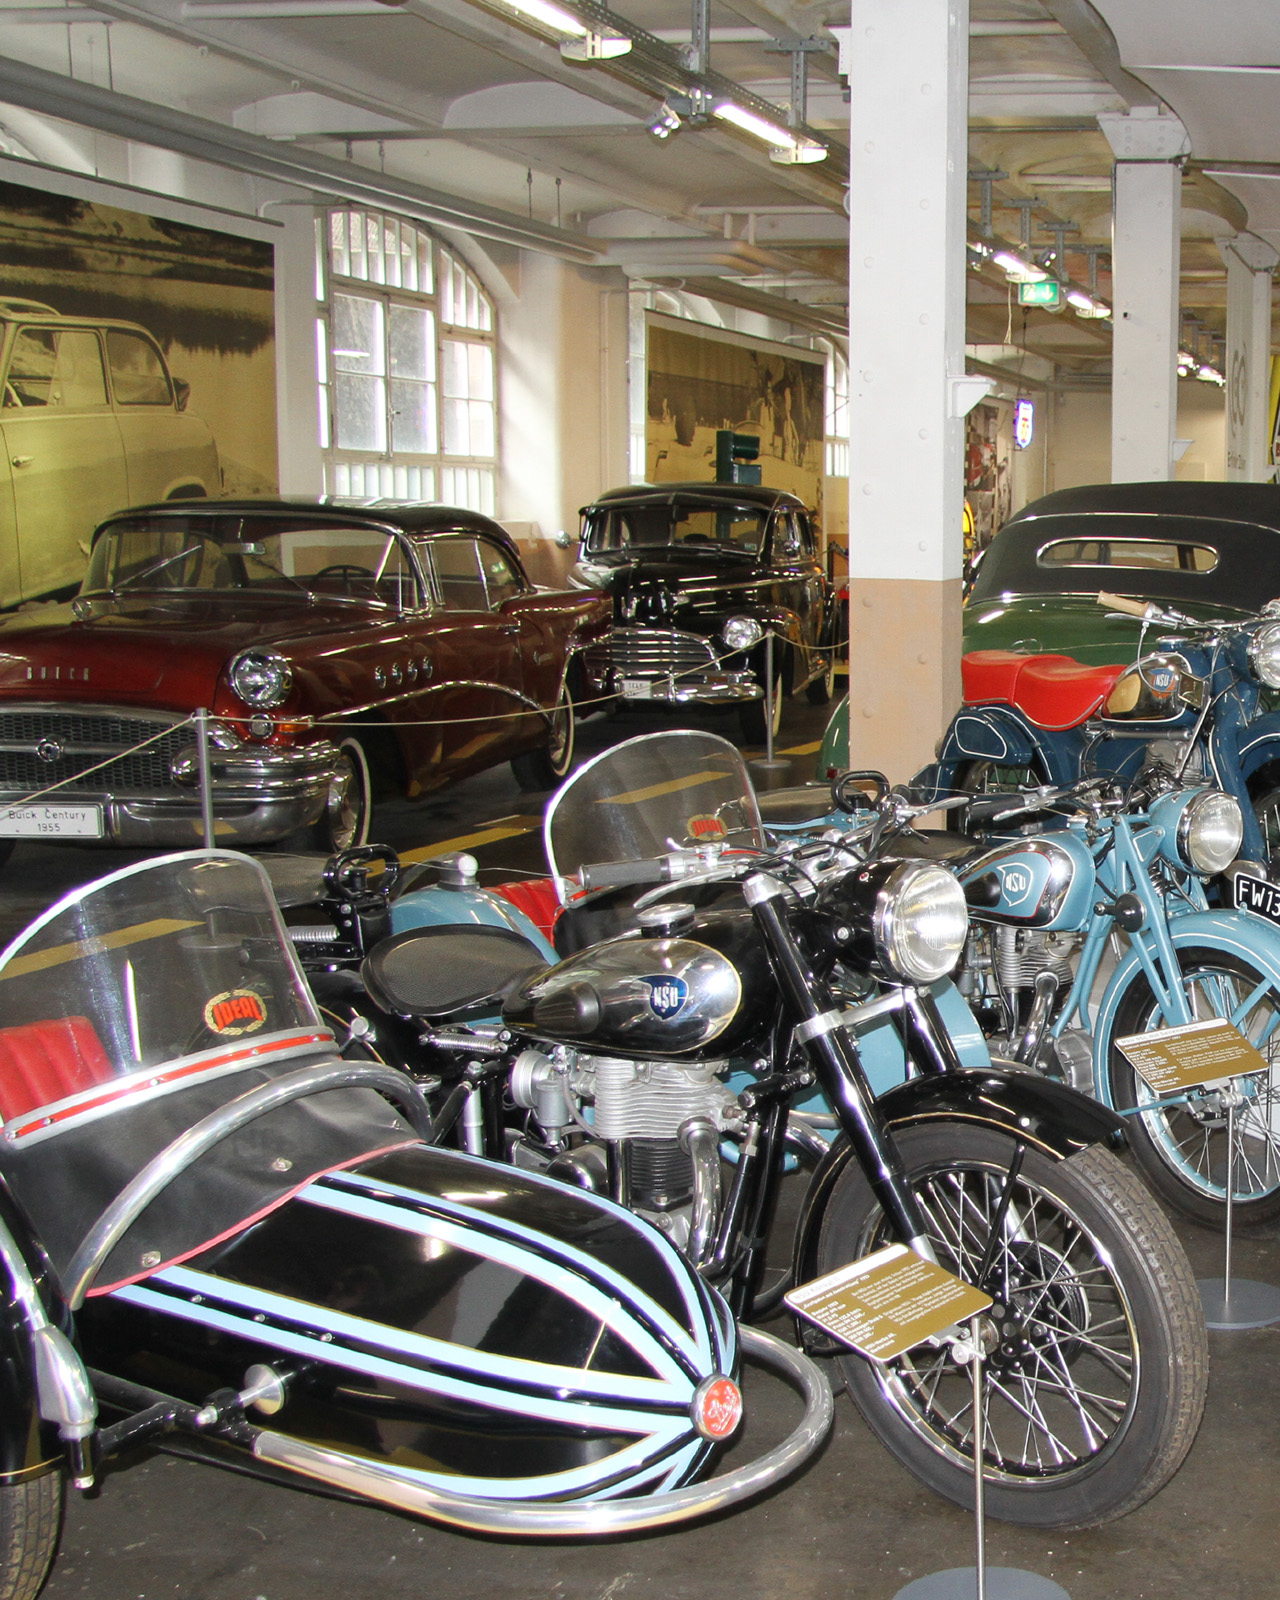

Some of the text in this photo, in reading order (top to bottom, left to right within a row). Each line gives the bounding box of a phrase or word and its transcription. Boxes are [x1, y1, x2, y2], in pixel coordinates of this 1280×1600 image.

[26, 666, 89, 680] BUICK
[1156, 673, 1170, 687] NSU
[8, 810, 86, 821] Buick Century
[37, 823, 61, 832] 1955
[1005, 872, 1026, 892] NSU
[653, 986, 679, 1009] NSU
[213, 996, 264, 1032] IDEAL
